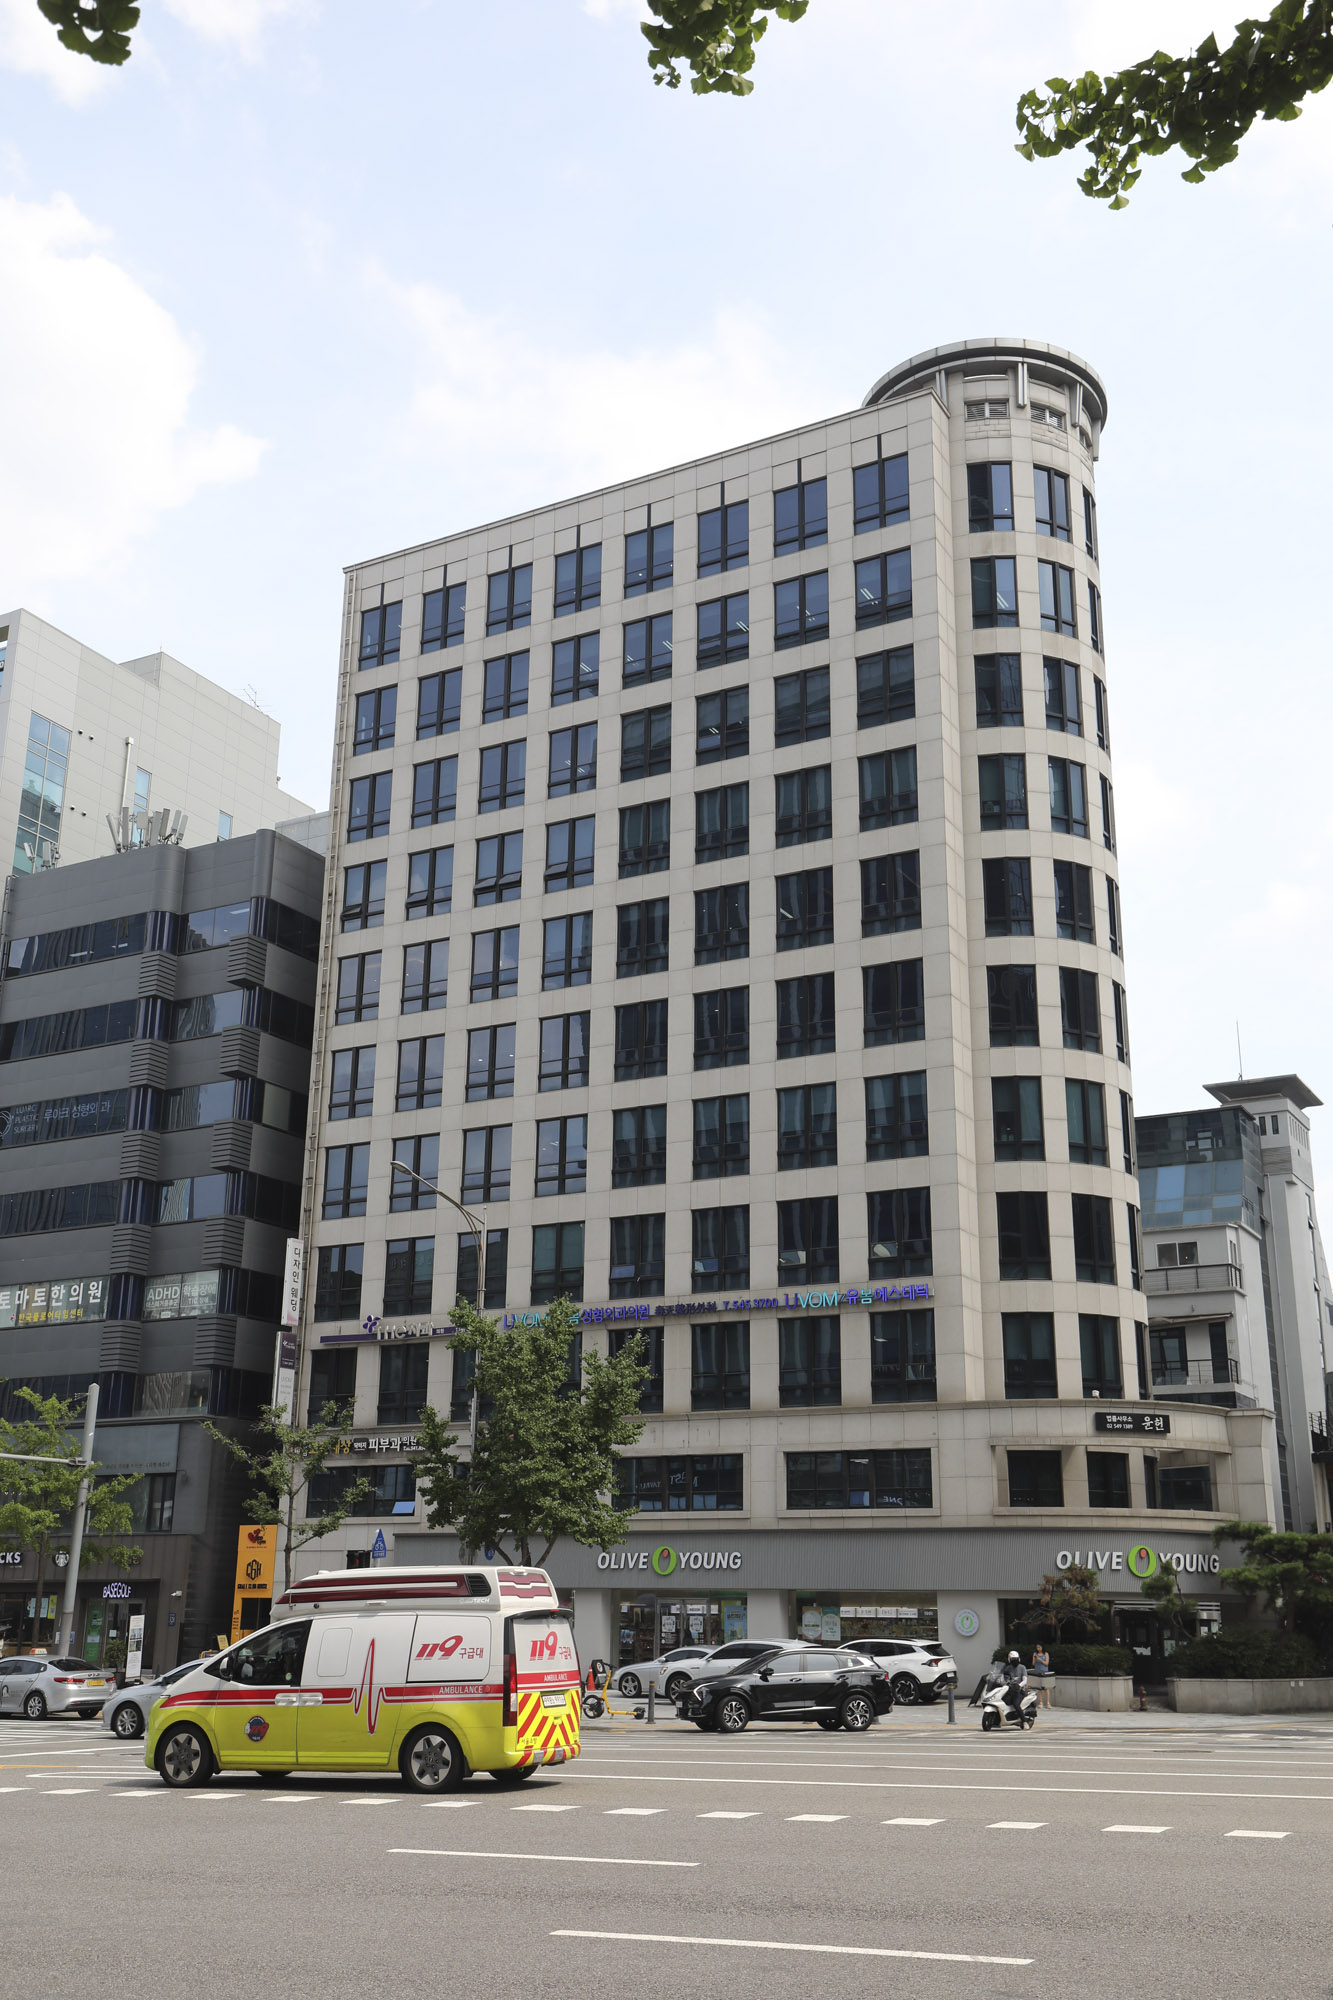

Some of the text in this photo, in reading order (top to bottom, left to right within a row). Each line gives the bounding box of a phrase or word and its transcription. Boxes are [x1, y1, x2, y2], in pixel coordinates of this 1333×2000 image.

[44, 1108, 70, 1121] 루아크
[292, 1248, 301, 1283] 디자인
[0, 1281, 102, 1310] 토마토한의원
[147, 1286, 180, 1300] ADHD
[291, 1287, 299, 1311] 웨딩
[785, 1283, 929, 1310] UVOM 유봄에스테틱
[368, 1437, 402, 1453] 피부과
[402, 1436, 417, 1446] 의원
[597, 1552, 648, 1569] OLIVE
[679, 1551, 742, 1569] YOUNG
[1056, 1551, 1123, 1570] OLIVE
[1158, 1552, 1220, 1573] YOUNG
[103, 1582, 131, 1598] BASEGOLF
[415, 1635, 484, 1659] 119 구급대
[529, 1631, 572, 1660] 119 구급대
[543, 1673, 568, 1682] AMBULANCE
[439, 1685, 483, 1694] AMBULANCE
